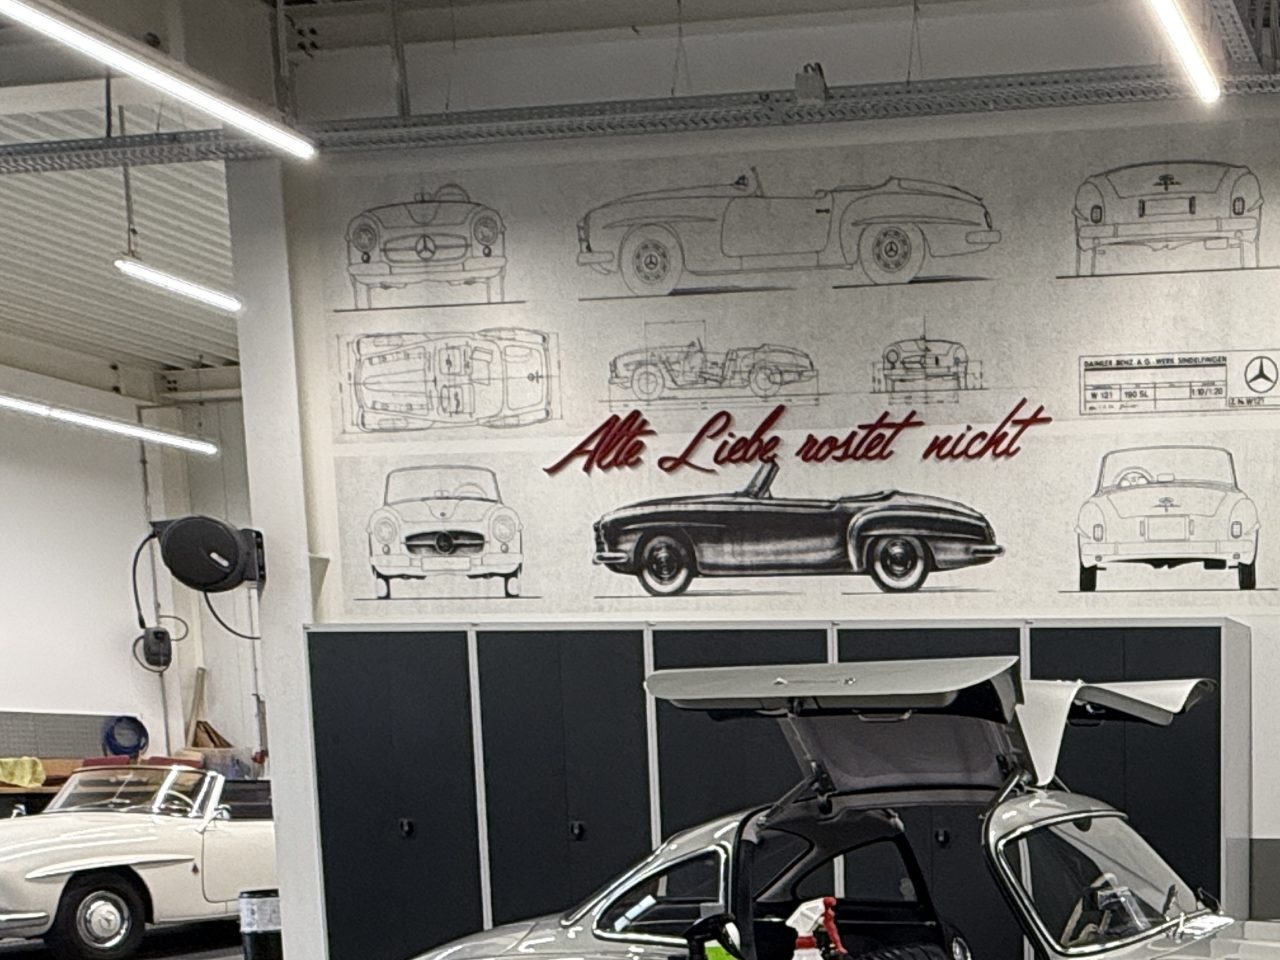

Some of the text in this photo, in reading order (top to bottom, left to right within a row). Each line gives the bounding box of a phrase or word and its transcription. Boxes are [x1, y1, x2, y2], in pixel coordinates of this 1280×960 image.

[1139, 390, 1149, 398] SL
[543, 397, 1052, 475] Alte Liebe rostet nicht
